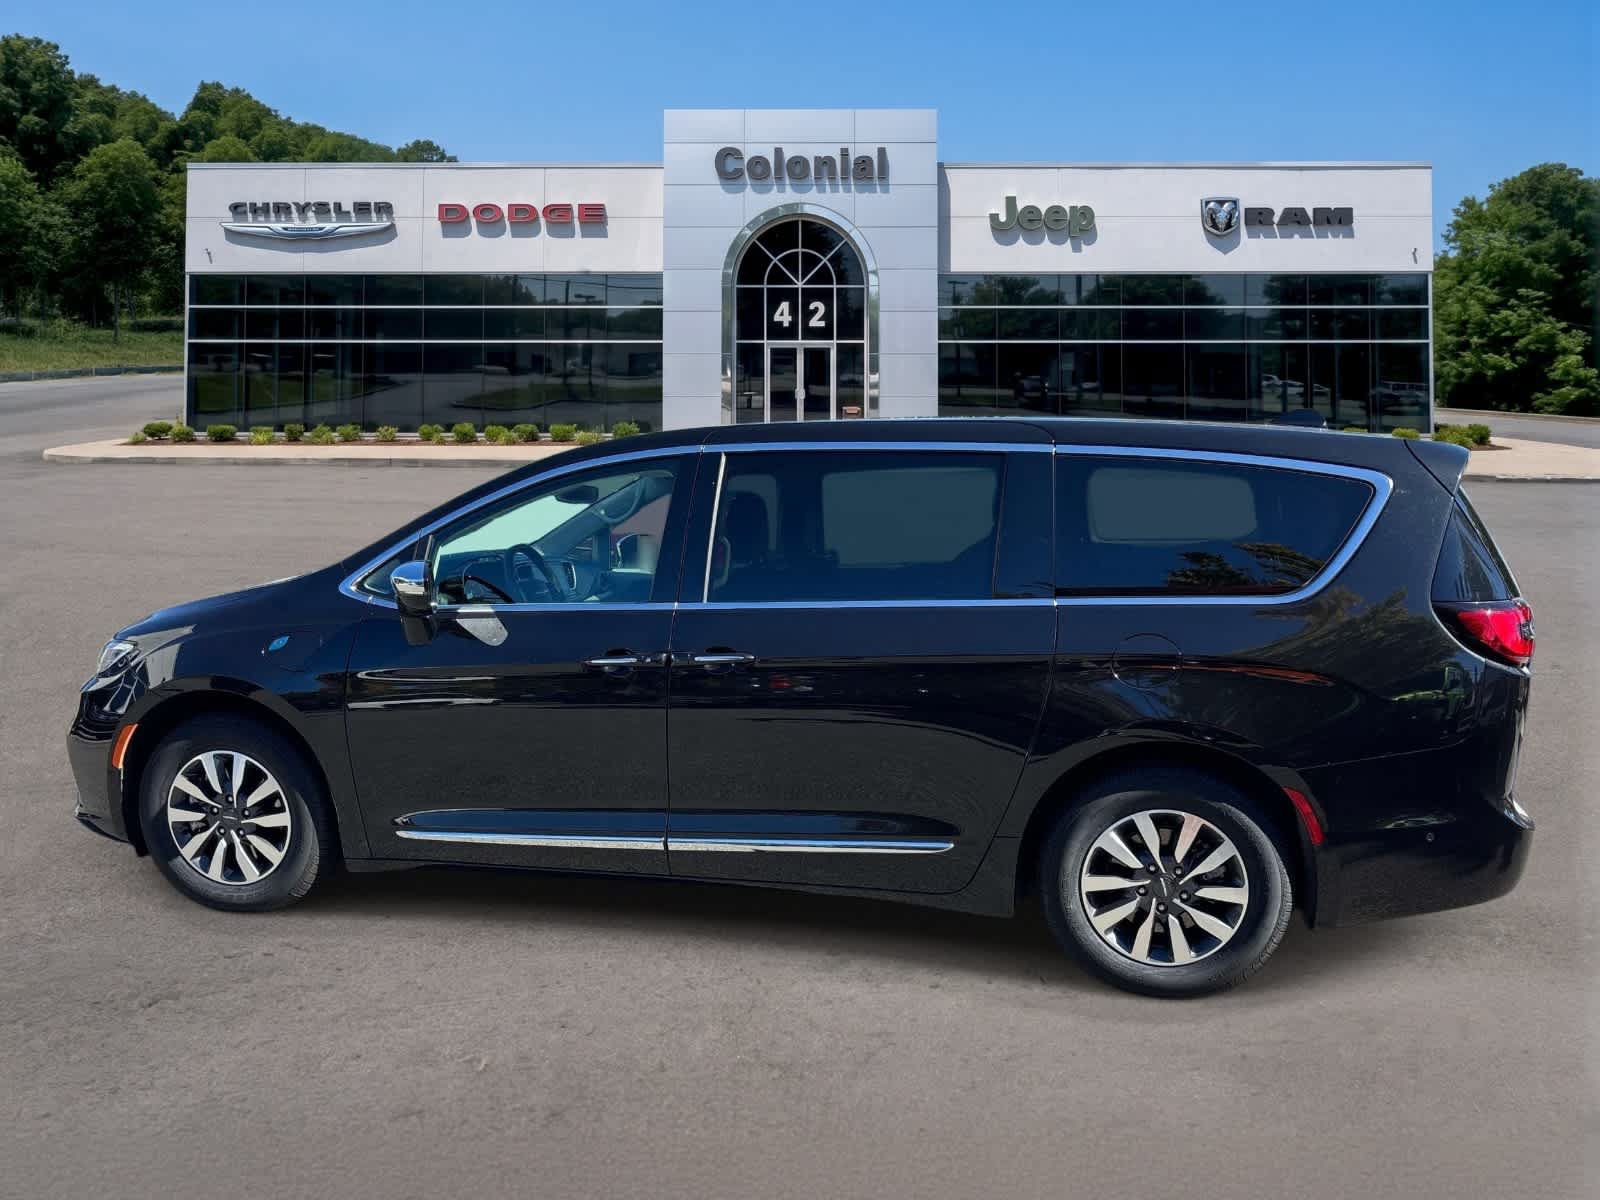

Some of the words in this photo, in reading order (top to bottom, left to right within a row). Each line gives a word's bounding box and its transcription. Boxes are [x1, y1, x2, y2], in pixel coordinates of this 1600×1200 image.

[714, 147, 888, 180] Colonial
[228, 201, 393, 217] CHRYSLER
[437, 202, 607, 222] DODGE
[989, 195, 1095, 238] Jeep
[1244, 207, 1353, 226] RAM
